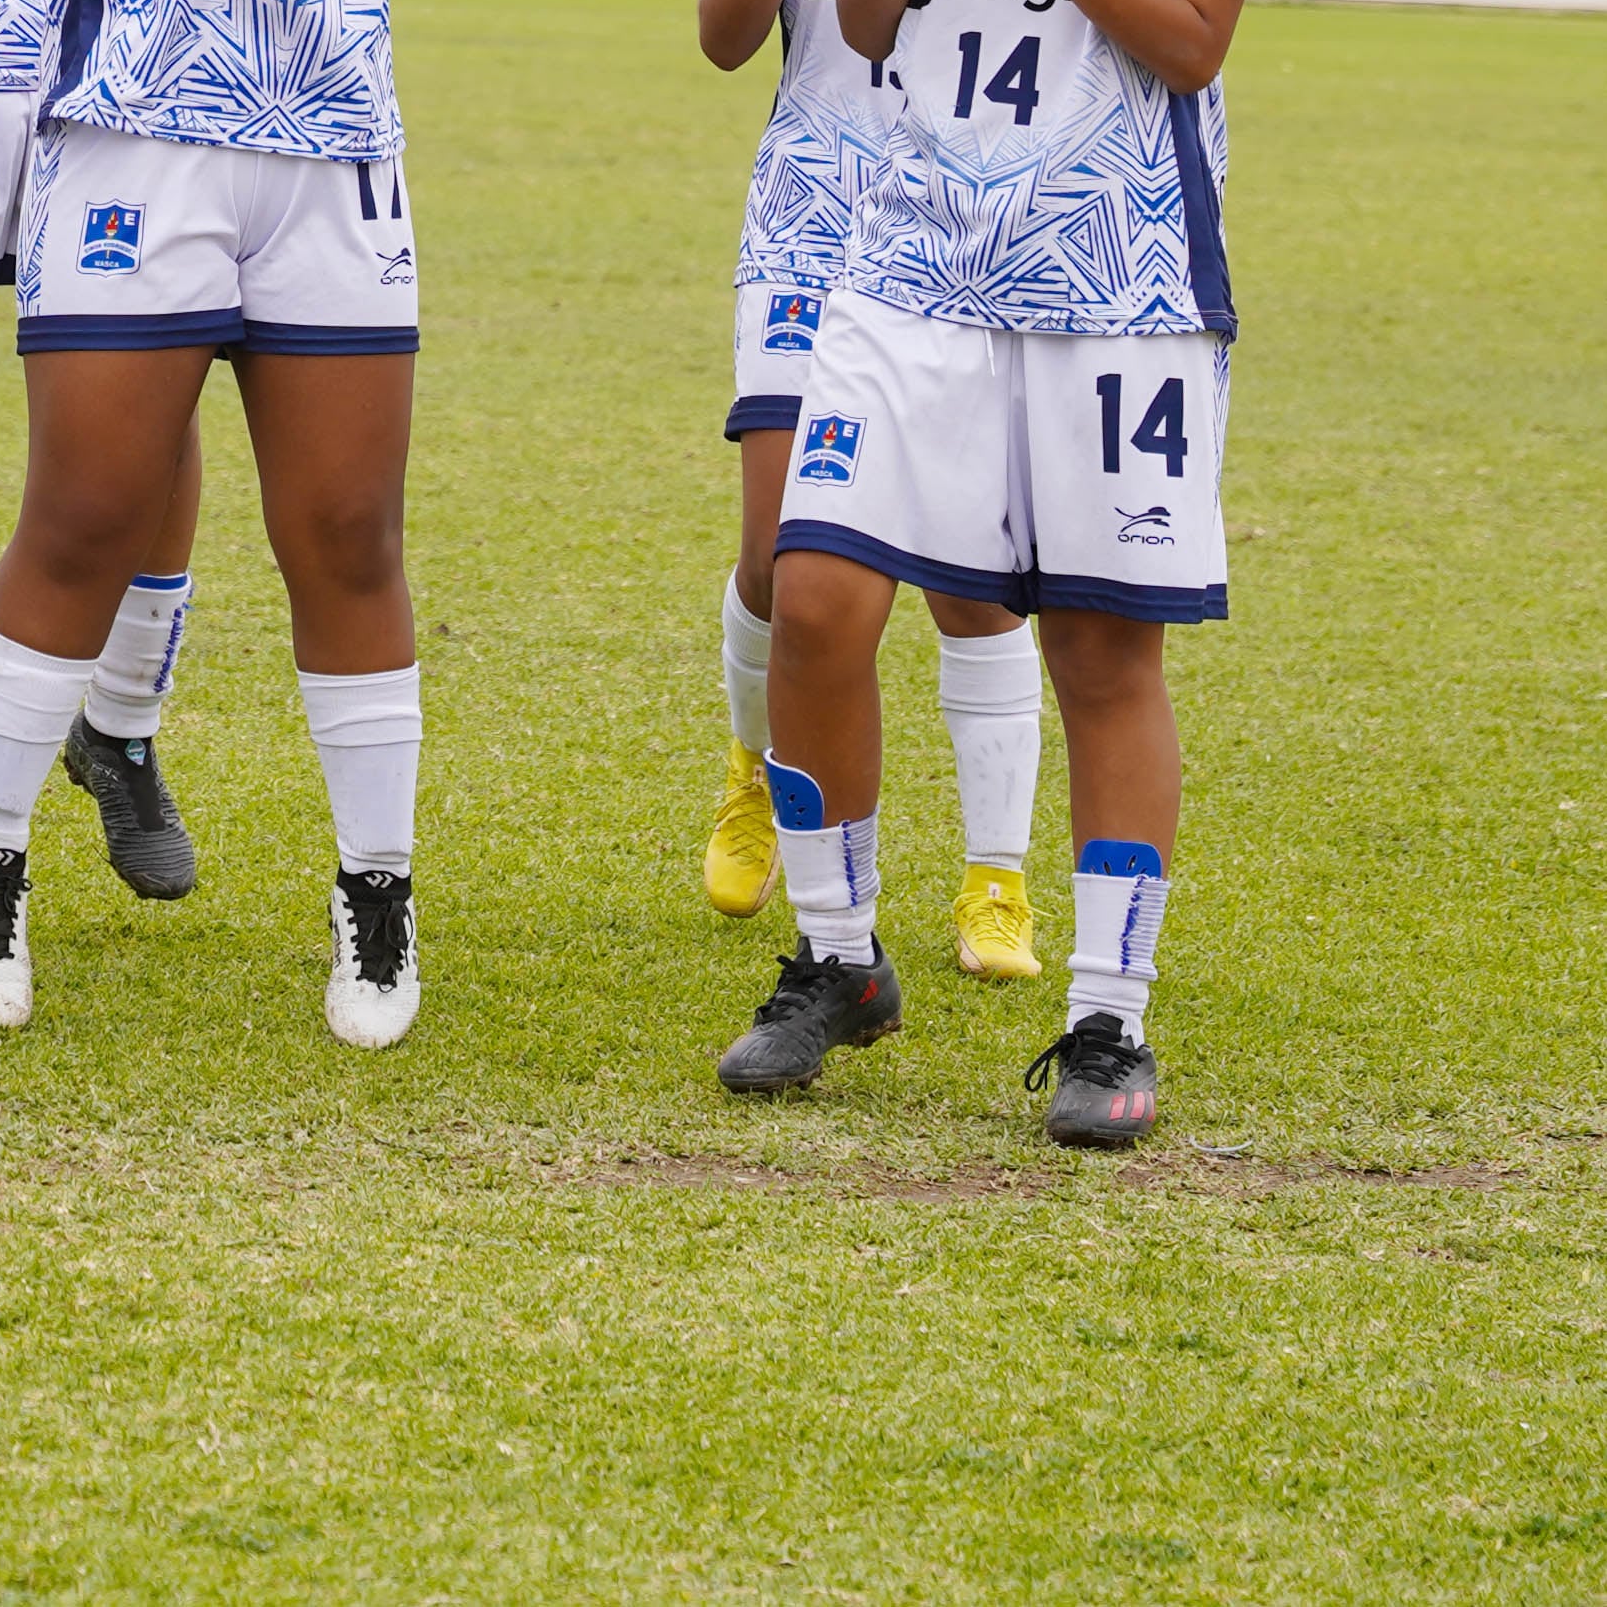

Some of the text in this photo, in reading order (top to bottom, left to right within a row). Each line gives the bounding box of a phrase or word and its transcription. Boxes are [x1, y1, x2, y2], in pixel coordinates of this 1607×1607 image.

[954, 31, 1041, 126] 14
[124, 213, 136, 226] E
[380, 275, 414, 285] orio
[806, 300, 818, 313] E
[842, 424, 856, 439] E
[1096, 373, 1188, 478] 14
[1117, 534, 1175, 545] orion
